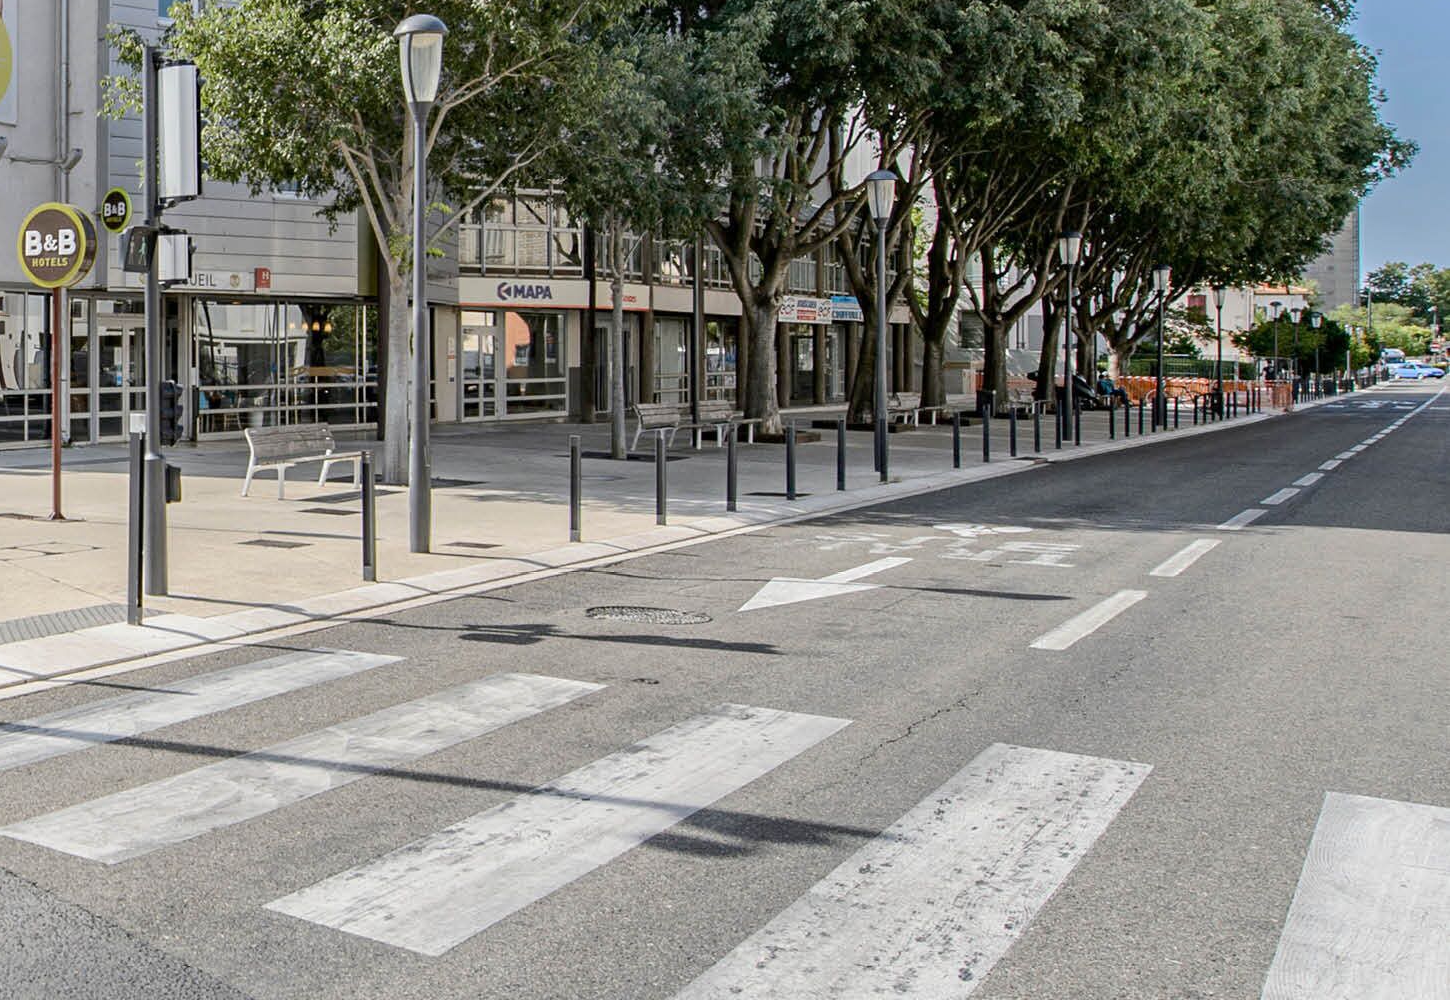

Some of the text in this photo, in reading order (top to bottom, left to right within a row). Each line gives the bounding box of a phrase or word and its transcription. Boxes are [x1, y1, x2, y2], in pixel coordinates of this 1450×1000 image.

[103, 202, 126, 217] B&B
[25, 228, 76, 256] B&B
[31, 257, 68, 267] HOTELS
[513, 284, 553, 299] MAPA
